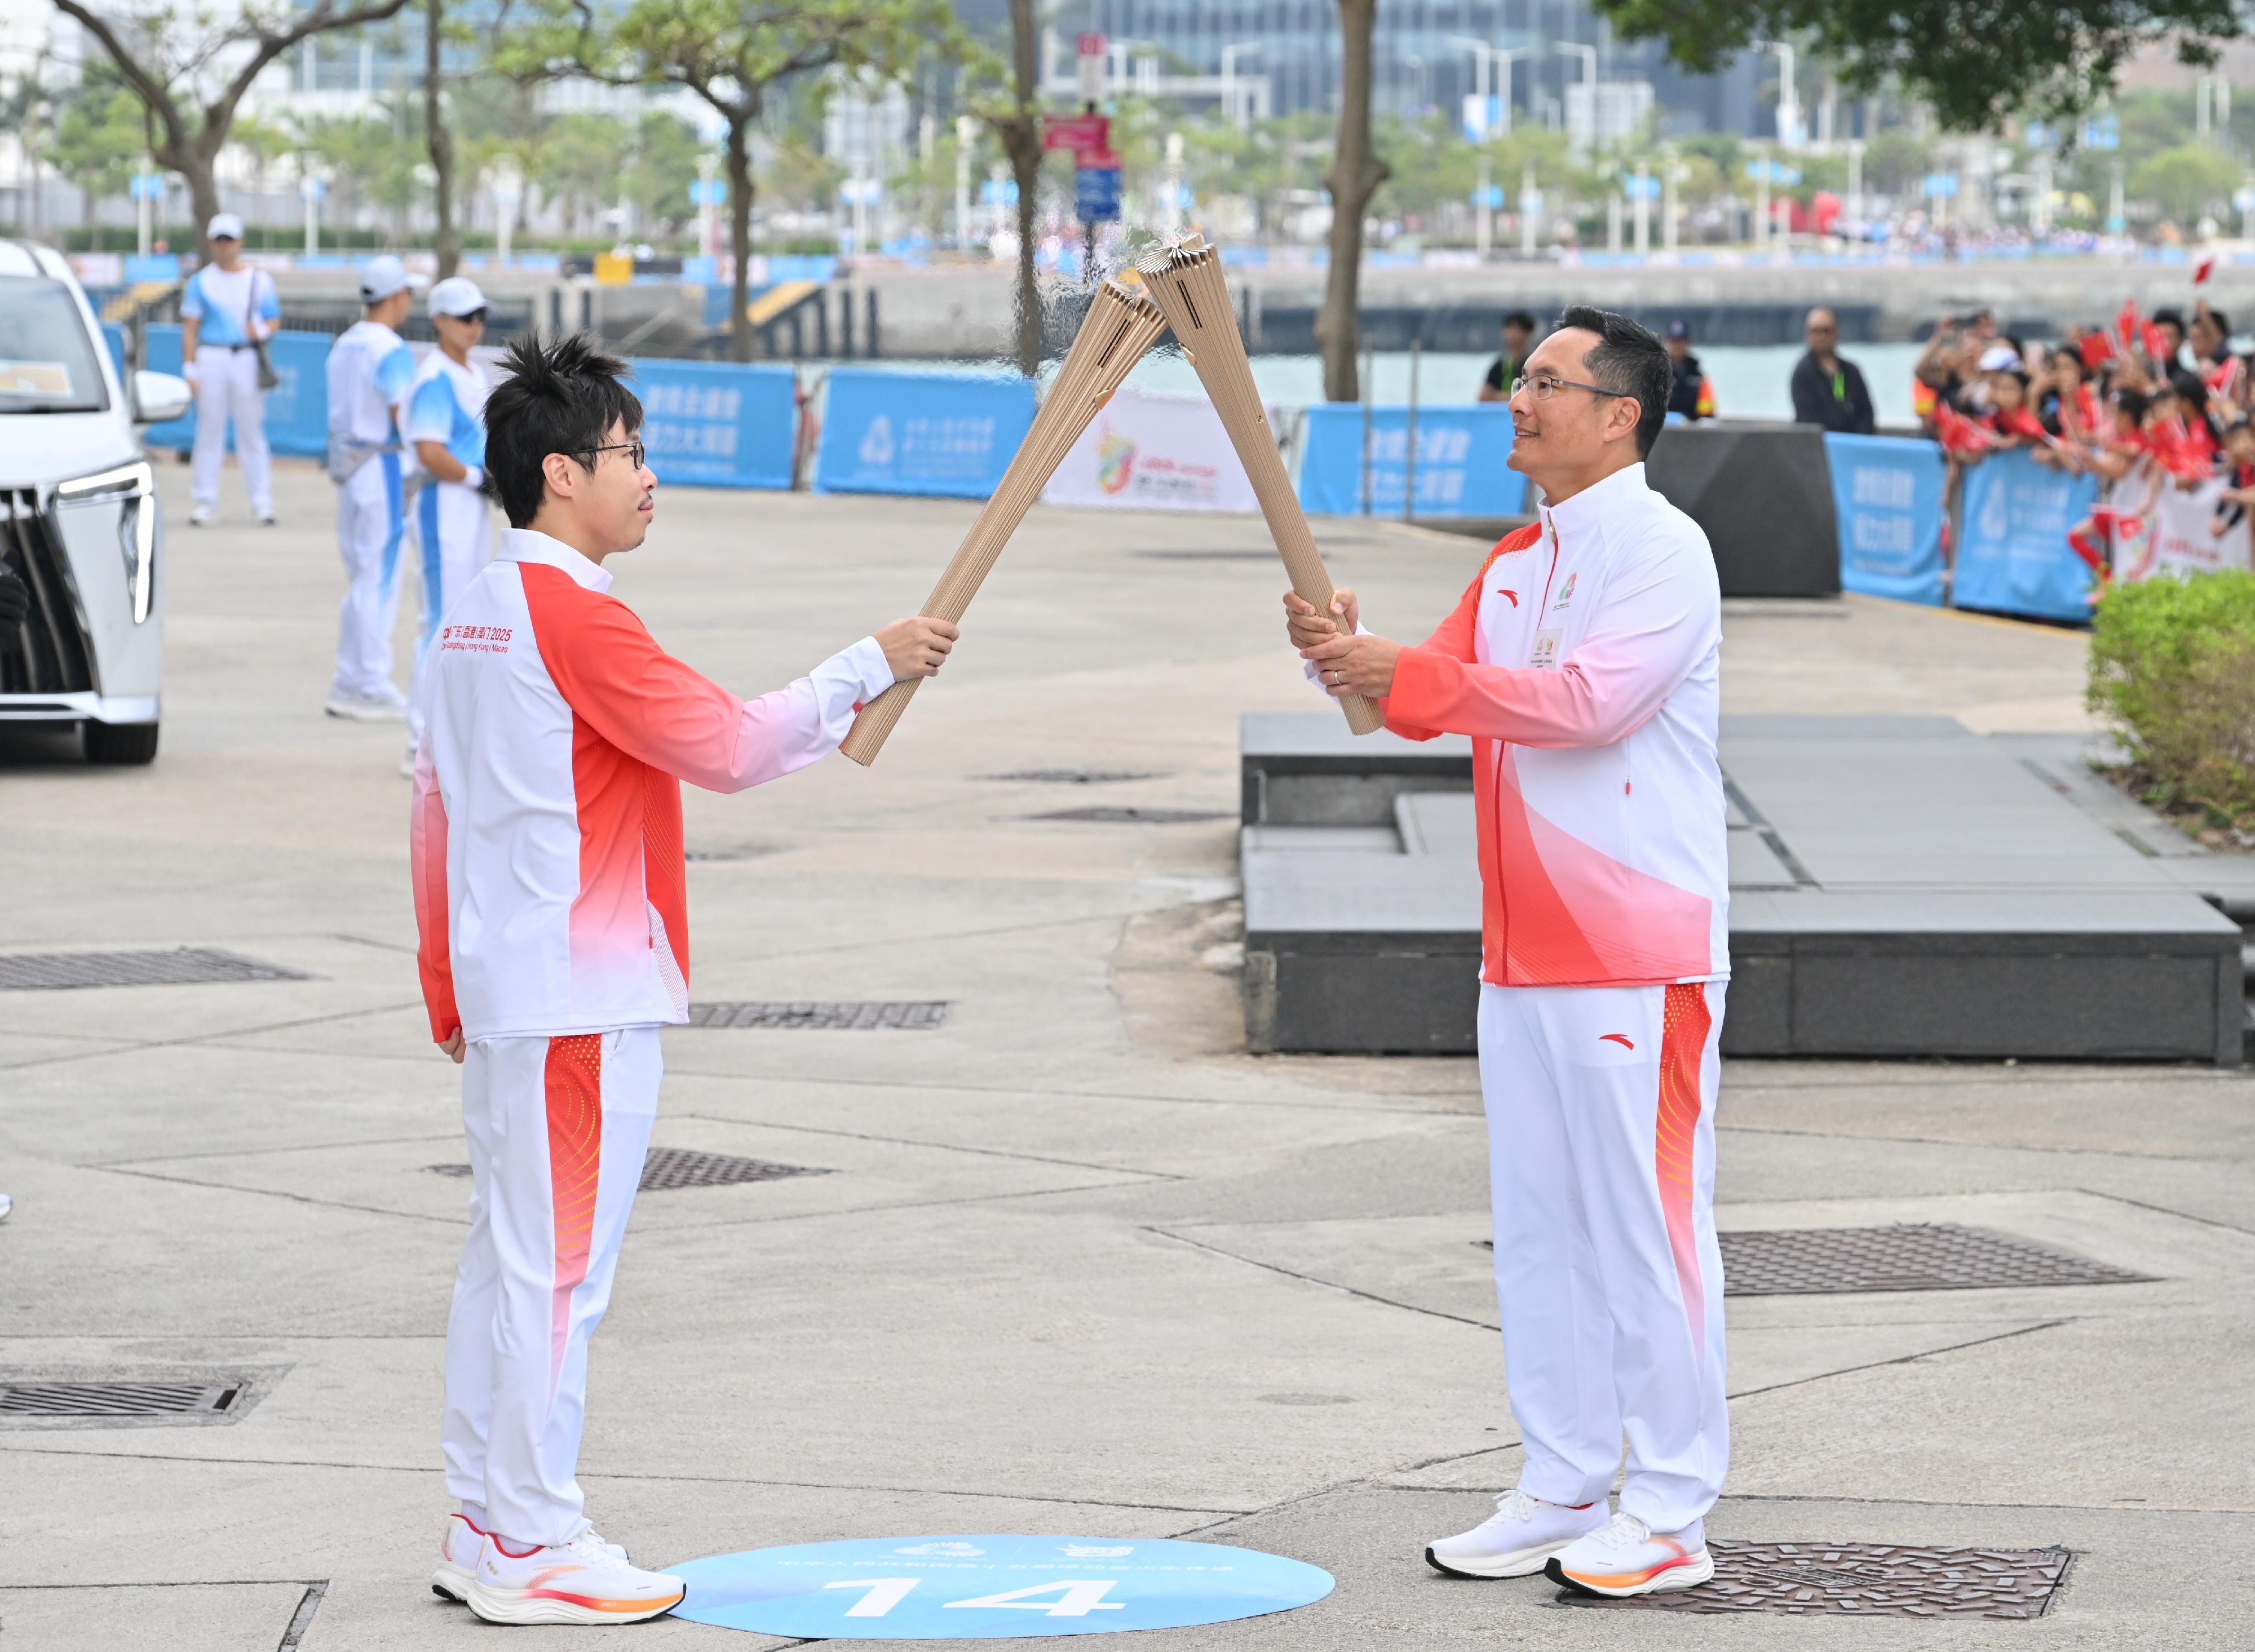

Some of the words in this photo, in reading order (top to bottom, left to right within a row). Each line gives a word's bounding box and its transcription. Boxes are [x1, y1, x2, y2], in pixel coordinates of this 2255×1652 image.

[467, 641, 478, 652] Hong
[479, 643, 489, 653] Kong
[492, 643, 508, 653] Macao
[823, 1578, 1127, 1617] 14
